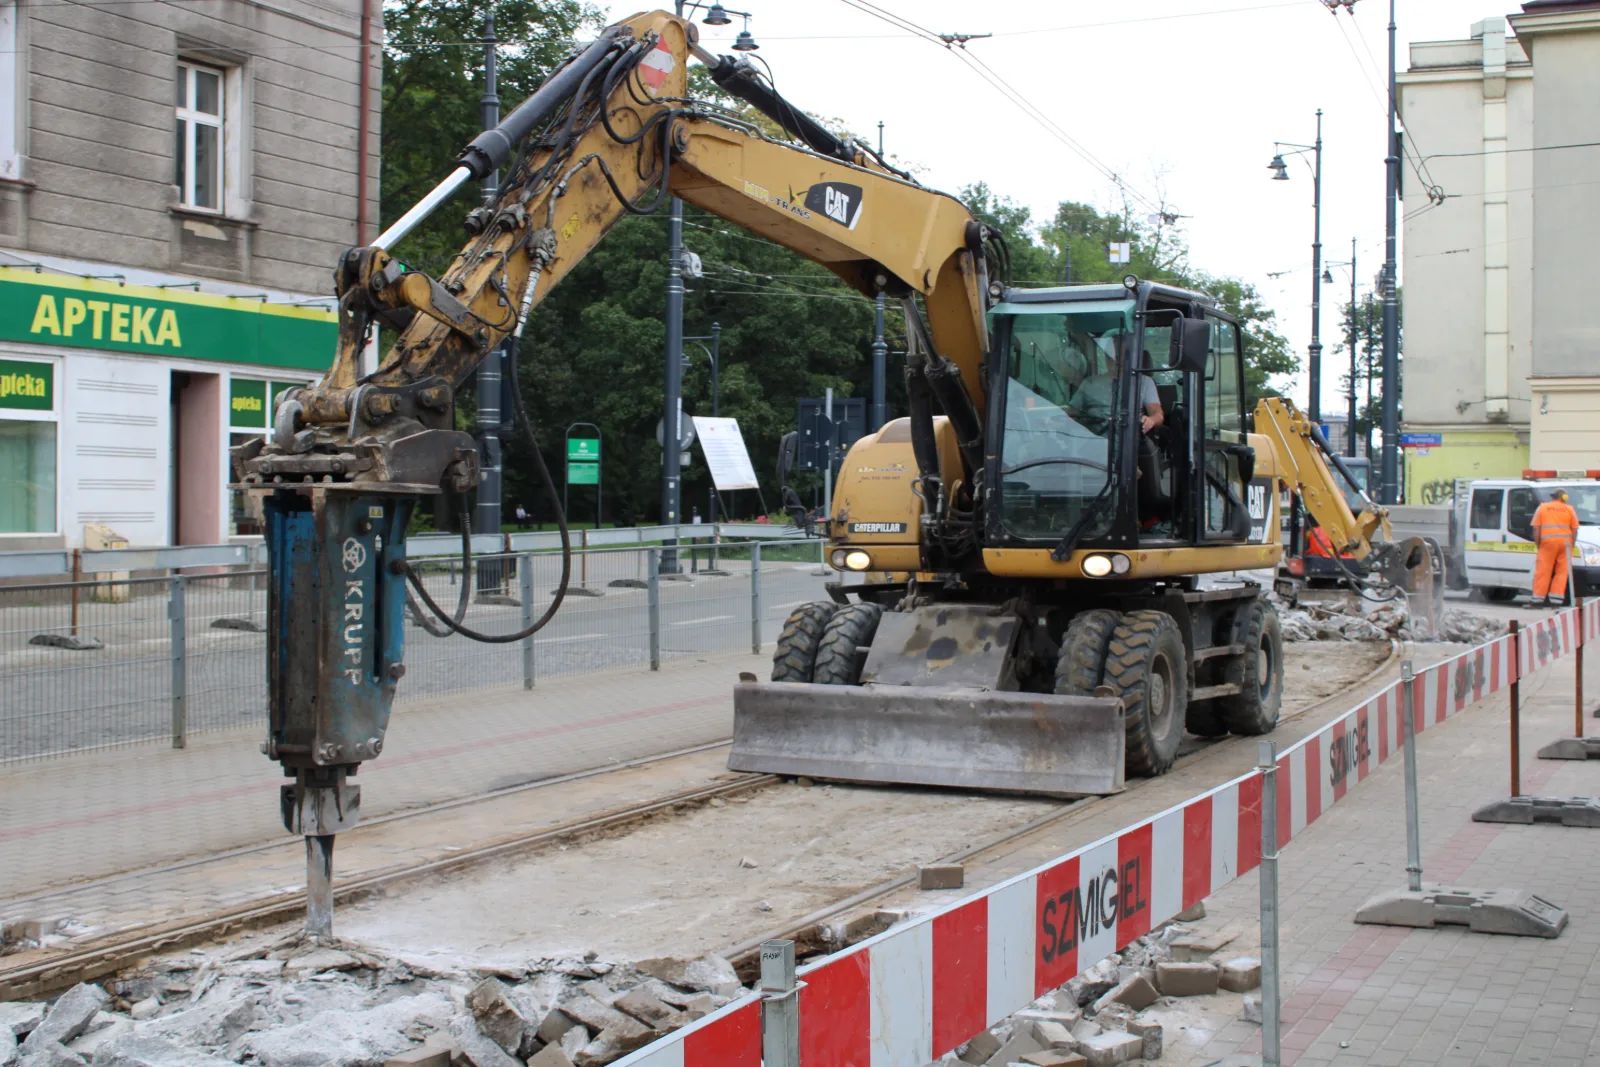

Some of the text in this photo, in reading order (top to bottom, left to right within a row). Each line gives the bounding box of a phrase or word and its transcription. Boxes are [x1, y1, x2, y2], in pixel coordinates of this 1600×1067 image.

[825, 186, 850, 223] CAT
[30, 294, 182, 348] APTEKA
[0, 372, 46, 398] pteka
[231, 396, 262, 412] apteka
[1247, 484, 1265, 520] CAT
[854, 523, 901, 533] CATERPILLAR
[344, 579, 364, 686] KRUPP
[1041, 855, 1146, 965] SZMIGIEL
